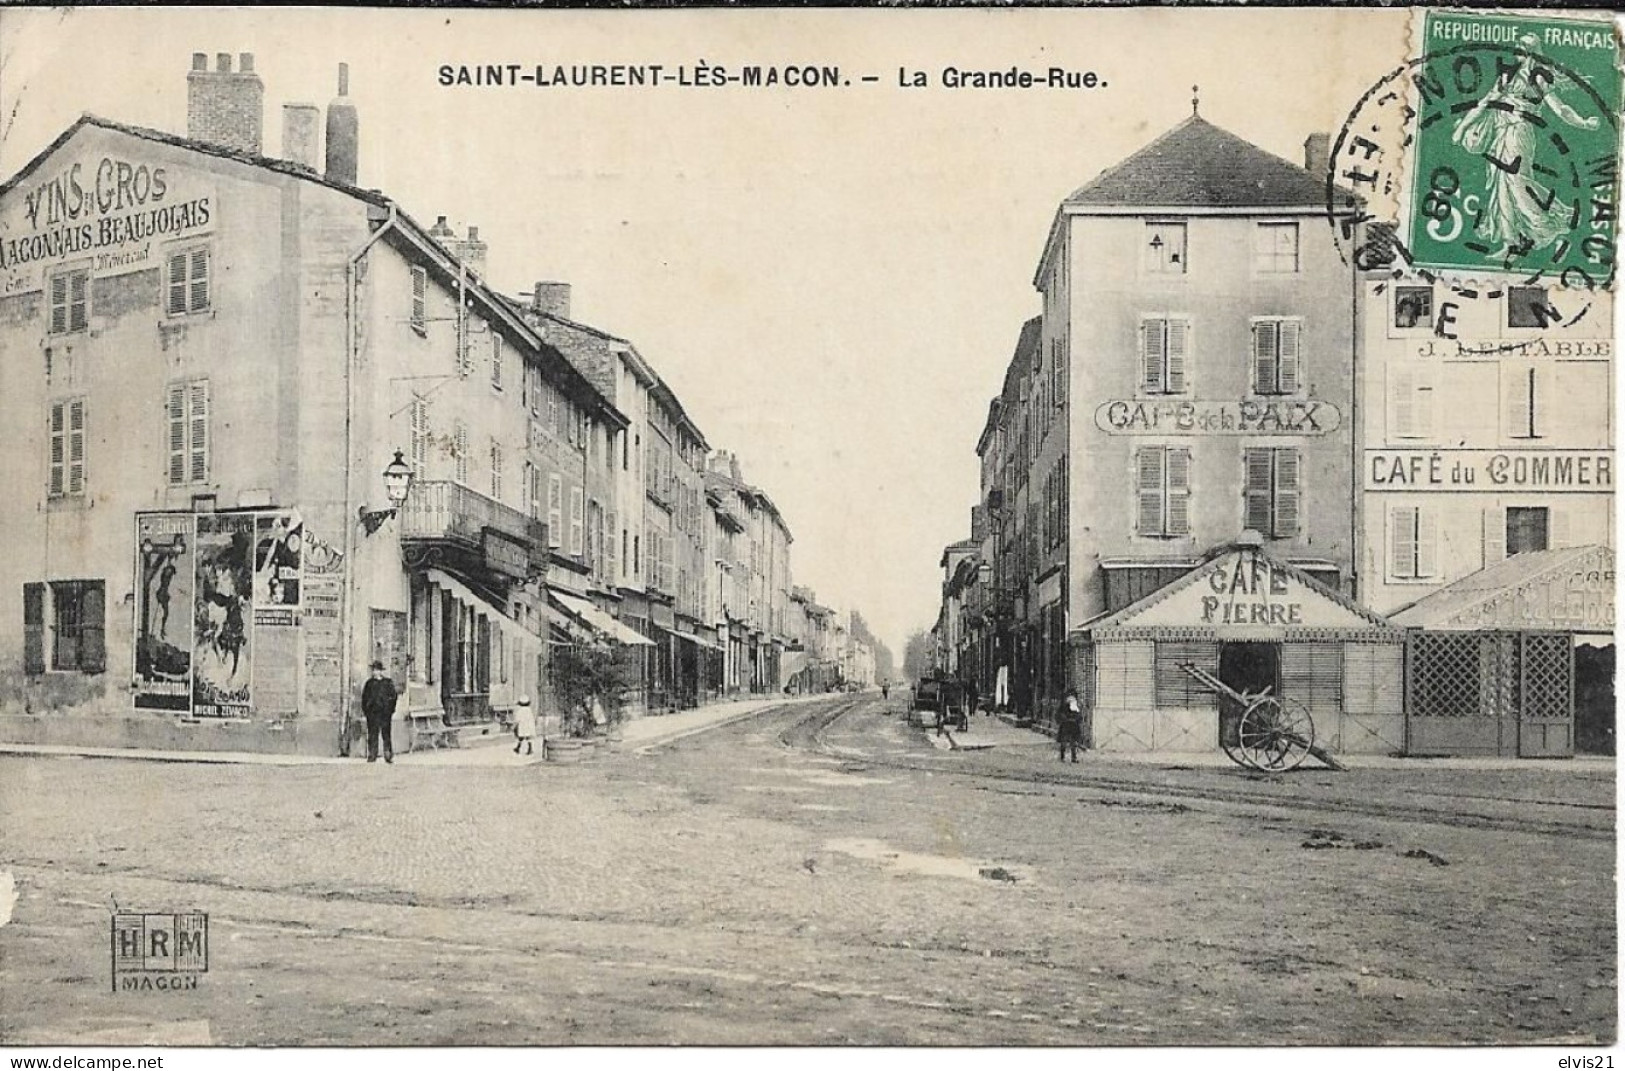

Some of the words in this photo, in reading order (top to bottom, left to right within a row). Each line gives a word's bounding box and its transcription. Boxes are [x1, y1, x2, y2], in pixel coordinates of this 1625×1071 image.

[25, 163, 83, 230] VINS
[97, 157, 167, 215] GROS
[98, 197, 210, 248] BEAUJOLAIS
[1238, 401, 1322, 431] PAIX
[1372, 453, 1442, 484] CAFÉ
[1451, 461, 1474, 484] du
[1201, 596, 1302, 624] PIERRE
